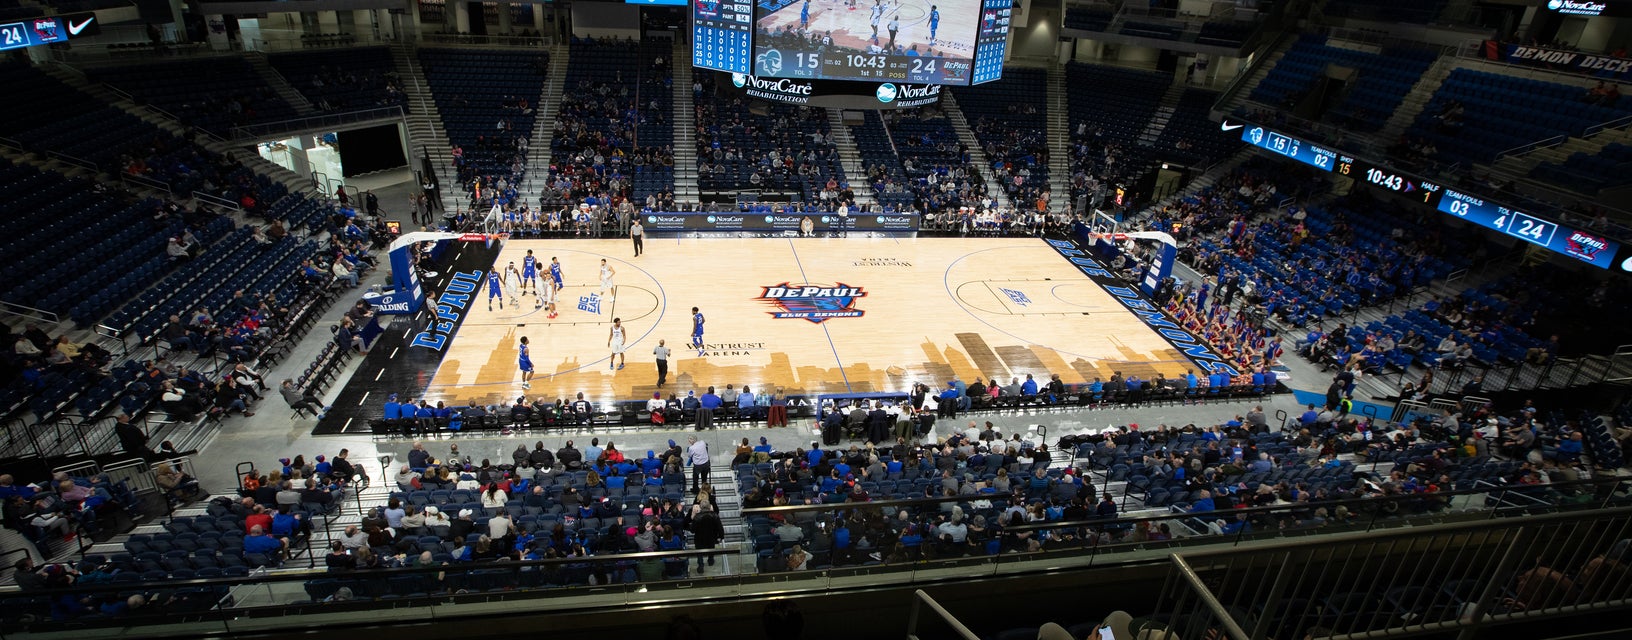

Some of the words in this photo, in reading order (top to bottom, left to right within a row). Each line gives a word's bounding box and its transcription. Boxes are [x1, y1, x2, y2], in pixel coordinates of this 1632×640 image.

[1560, 0, 1606, 10] NovaCare
[2, 27, 22, 45] 24
[796, 53, 819, 68] 15
[847, 54, 886, 68] 10:43
[912, 59, 936, 74] 24
[1512, 46, 1576, 65] DEMON
[1579, 56, 1632, 72] DECK
[746, 75, 812, 95] NovaCare
[897, 84, 941, 99] NovaCare
[746, 89, 809, 104] REHABILITATION
[1274, 137, 1285, 150] 15
[1291, 146, 1298, 156] 3
[1314, 154, 1328, 167] 02
[1322, 149, 1337, 158] FOULS
[1340, 162, 1351, 175] 15
[1367, 168, 1402, 190] 10:43
[1421, 181, 1440, 192] HALF
[1424, 192, 1431, 203] 1
[1445, 189, 1462, 200] TEAM
[1462, 195, 1484, 206] FOULS
[1450, 200, 1469, 216] 03
[1498, 207, 1510, 215] TOL
[1493, 216, 1506, 228] 4
[1518, 220, 1545, 239] 24
[578, 296, 589, 311] BIG
[587, 292, 600, 313] EAST
[1044, 237, 1115, 279] BLUE
[1103, 284, 1240, 376] DEMONS
